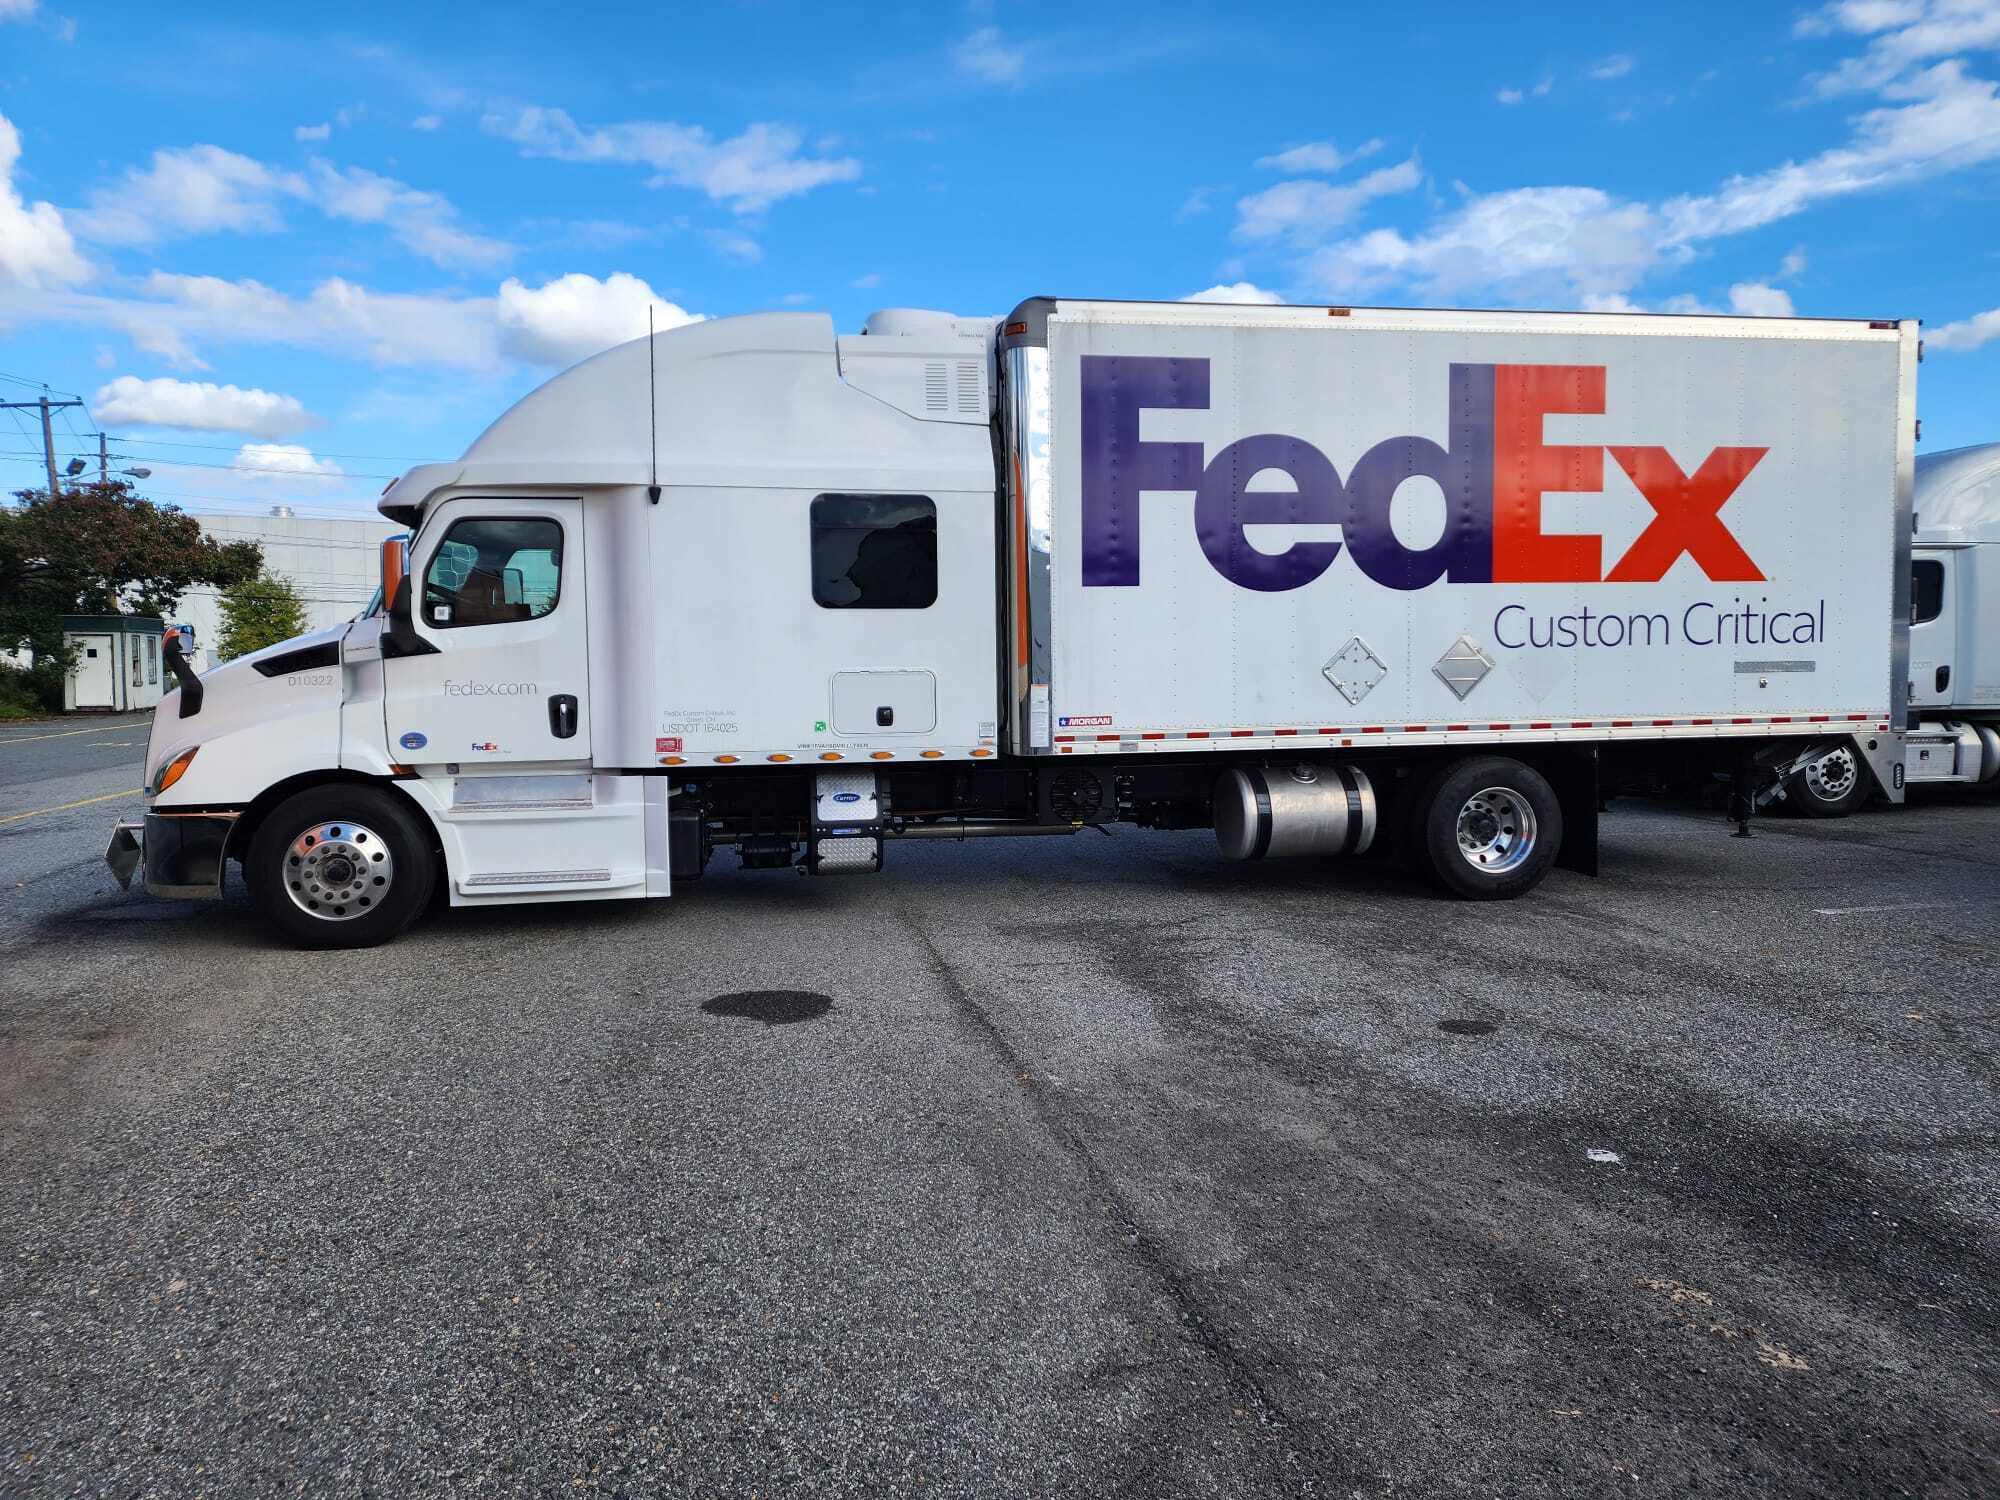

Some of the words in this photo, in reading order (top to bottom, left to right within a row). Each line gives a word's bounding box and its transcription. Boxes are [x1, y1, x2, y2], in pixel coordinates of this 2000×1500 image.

[1080, 354, 1770, 592] FedEx
[1494, 604, 1669, 649] Custom
[1683, 597, 1825, 646] Critical
[288, 675, 334, 687] D10322
[441, 680, 537, 697] fedex.com
[1069, 717, 1111, 726] MORGAN
[662, 723, 699, 734] USDOT
[703, 722, 739, 733] 164025
[471, 742, 498, 751] FedEx
